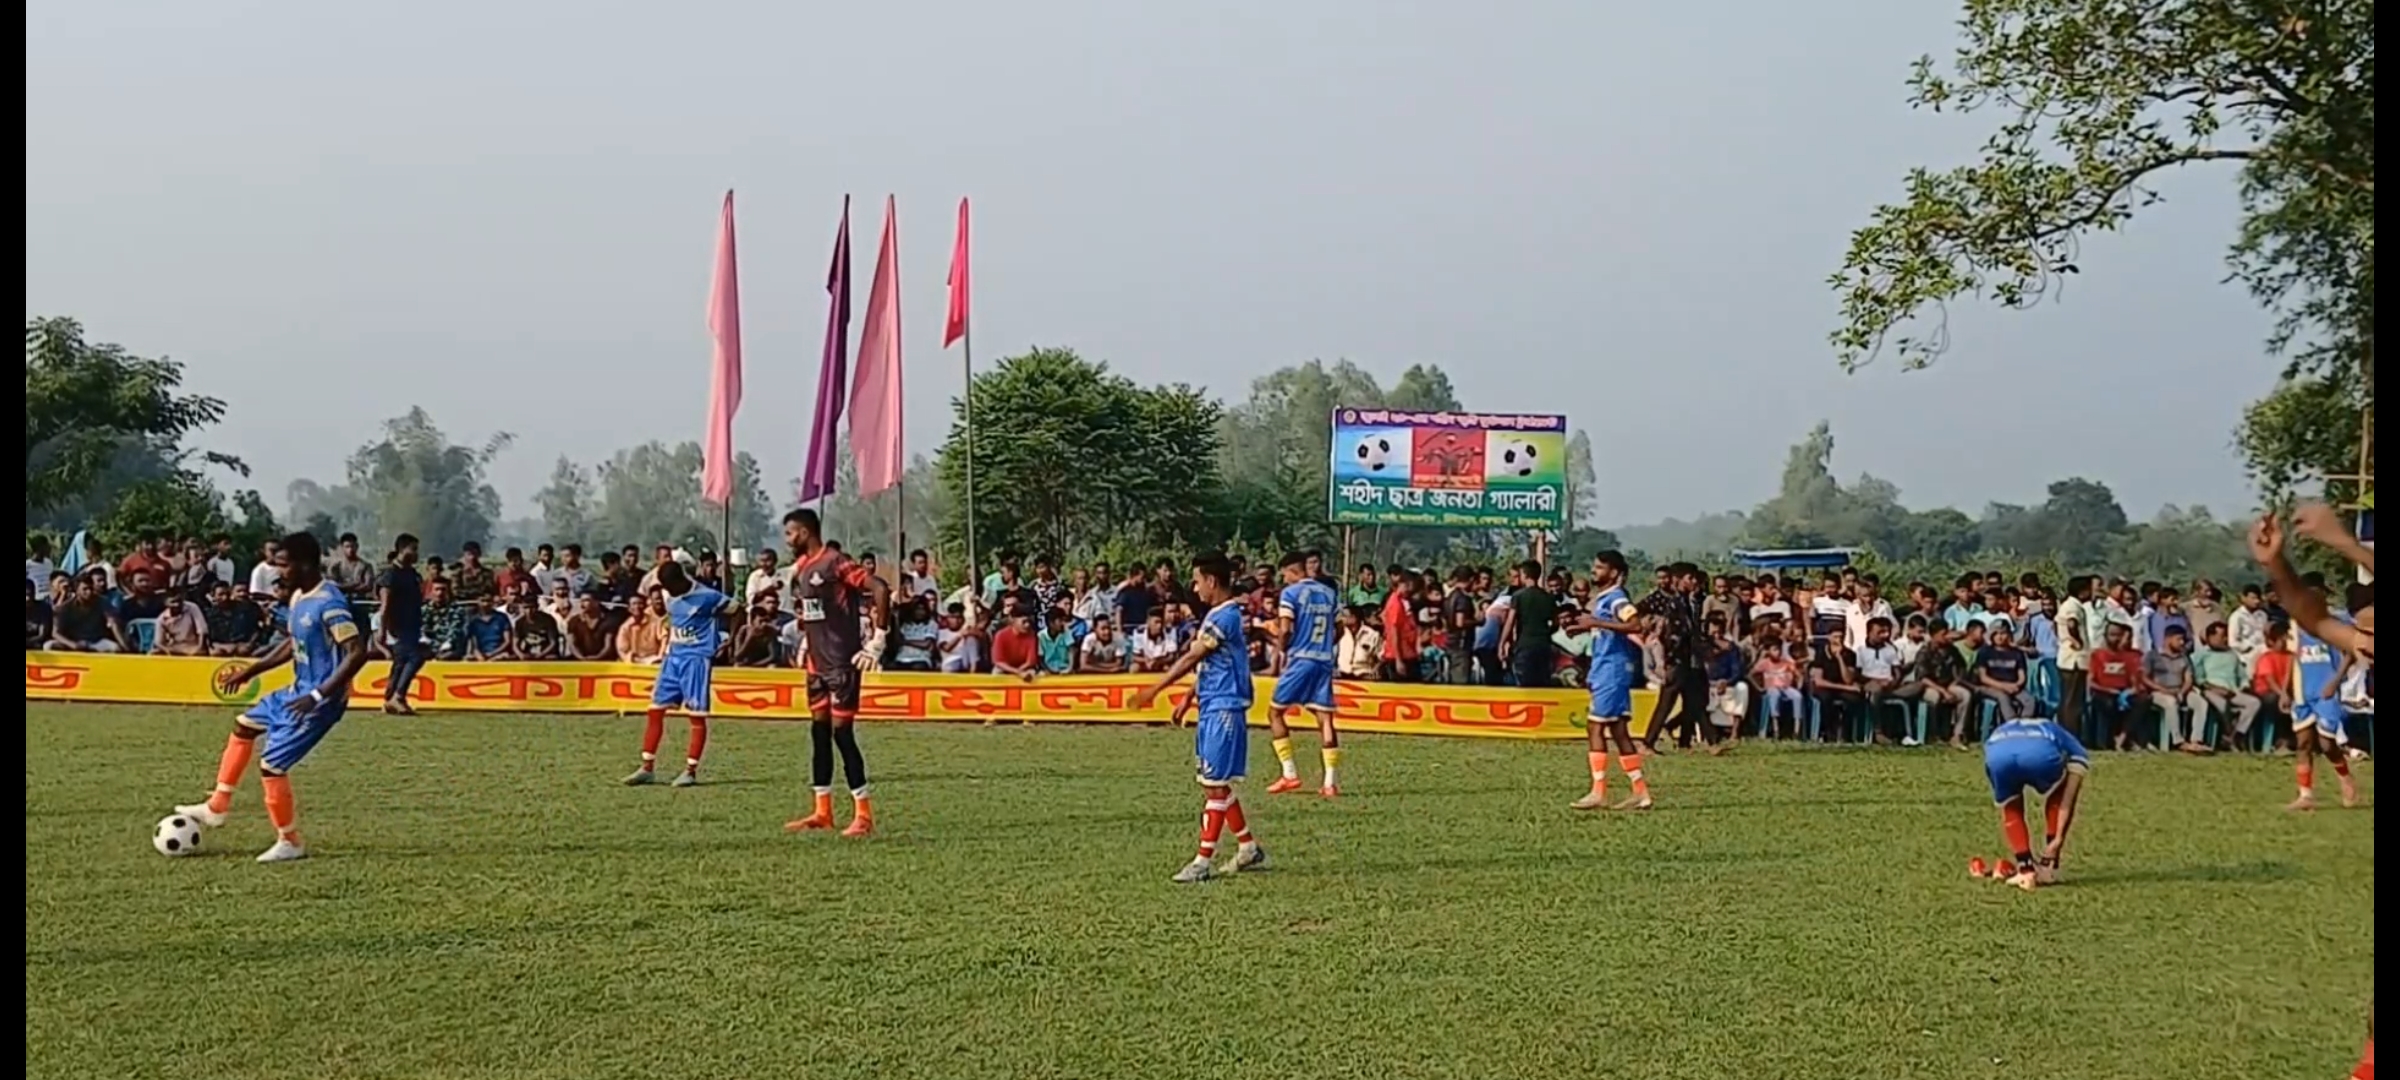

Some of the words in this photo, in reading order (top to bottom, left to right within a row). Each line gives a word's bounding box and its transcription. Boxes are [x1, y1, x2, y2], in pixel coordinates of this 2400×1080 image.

[1339, 479, 1383, 507] শহীদ
[1389, 487, 1425, 510] ছাত্র
[1430, 489, 1485, 509] জনতা
[1490, 485, 1557, 512] গ্যালারী
[1310, 615, 1328, 644] 2
